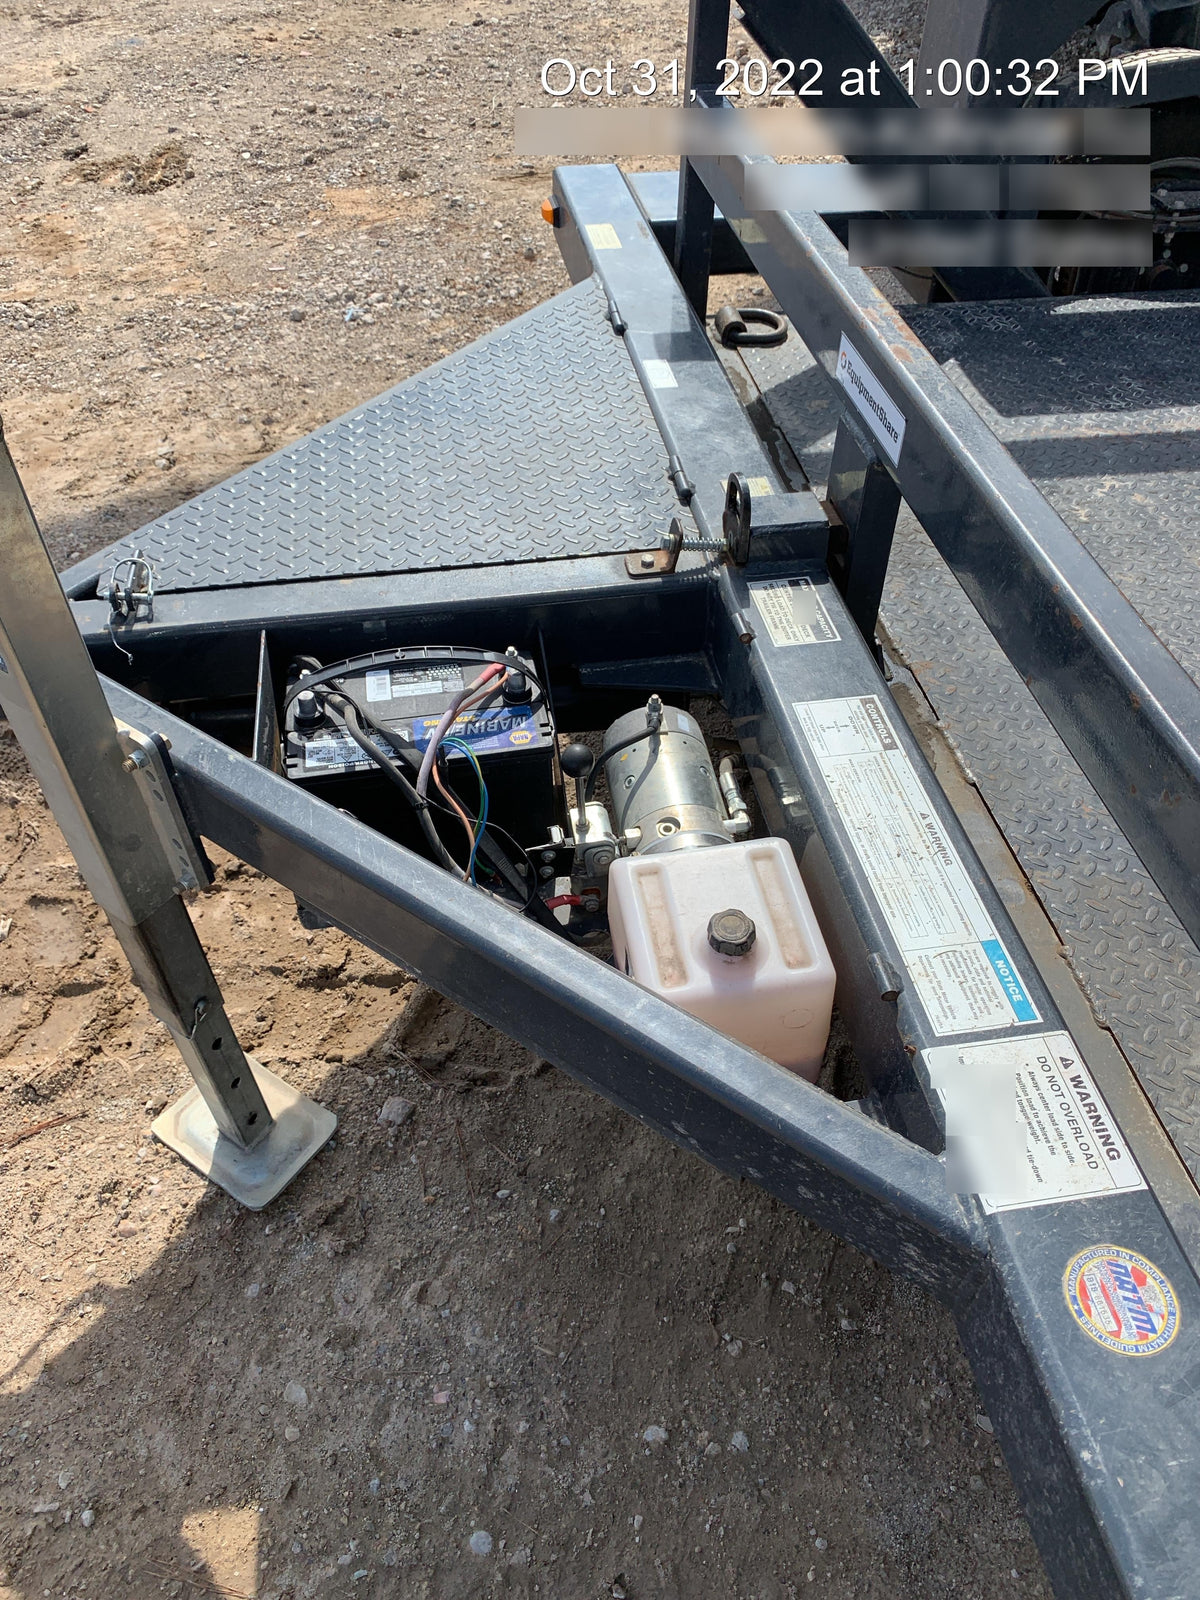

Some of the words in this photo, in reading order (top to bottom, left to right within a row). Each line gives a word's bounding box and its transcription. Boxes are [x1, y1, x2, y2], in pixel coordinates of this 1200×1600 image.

[846, 359, 898, 445] EquipmentShare
[425, 716, 529, 739] MARINE/V
[818, 724, 826, 732] UP
[847, 715, 860, 734] DOWN
[864, 703, 892, 743] CONTROLS
[924, 822, 953, 866] WARNING
[994, 959, 1023, 1001] NOTICE
[1013, 1072, 1030, 1096] Position
[1025, 1097, 1037, 1110] load
[1035, 1119, 1052, 1143] achieve
[1046, 1144, 1057, 1155] the
[1015, 1099, 1030, 1119] tongue
[1025, 1121, 1042, 1144] weight.
[1026, 1071, 1042, 1091] Always
[1037, 1092, 1051, 1111] center
[1046, 1113, 1059, 1126] load
[1053, 1127, 1065, 1140] side
[1063, 1149, 1077, 1165] side.
[1035, 1055, 1052, 1072] DO
[1045, 1075, 1065, 1099] NOT
[1057, 1101, 1099, 1170] OVERLOAD
[1068, 1074, 1122, 1161] WARNING
[1026, 1154, 1044, 1182] tie-down
[1068, 1249, 1117, 1295] MANUFACTURED
[1119, 1252, 1130, 1260] IN
[1132, 1255, 1176, 1314] COMPLIANCE
[1080, 1316, 1136, 1352] GUIDELINES
[1140, 1337, 1167, 1353] NATM
[1163, 1315, 1176, 1339] WITH
